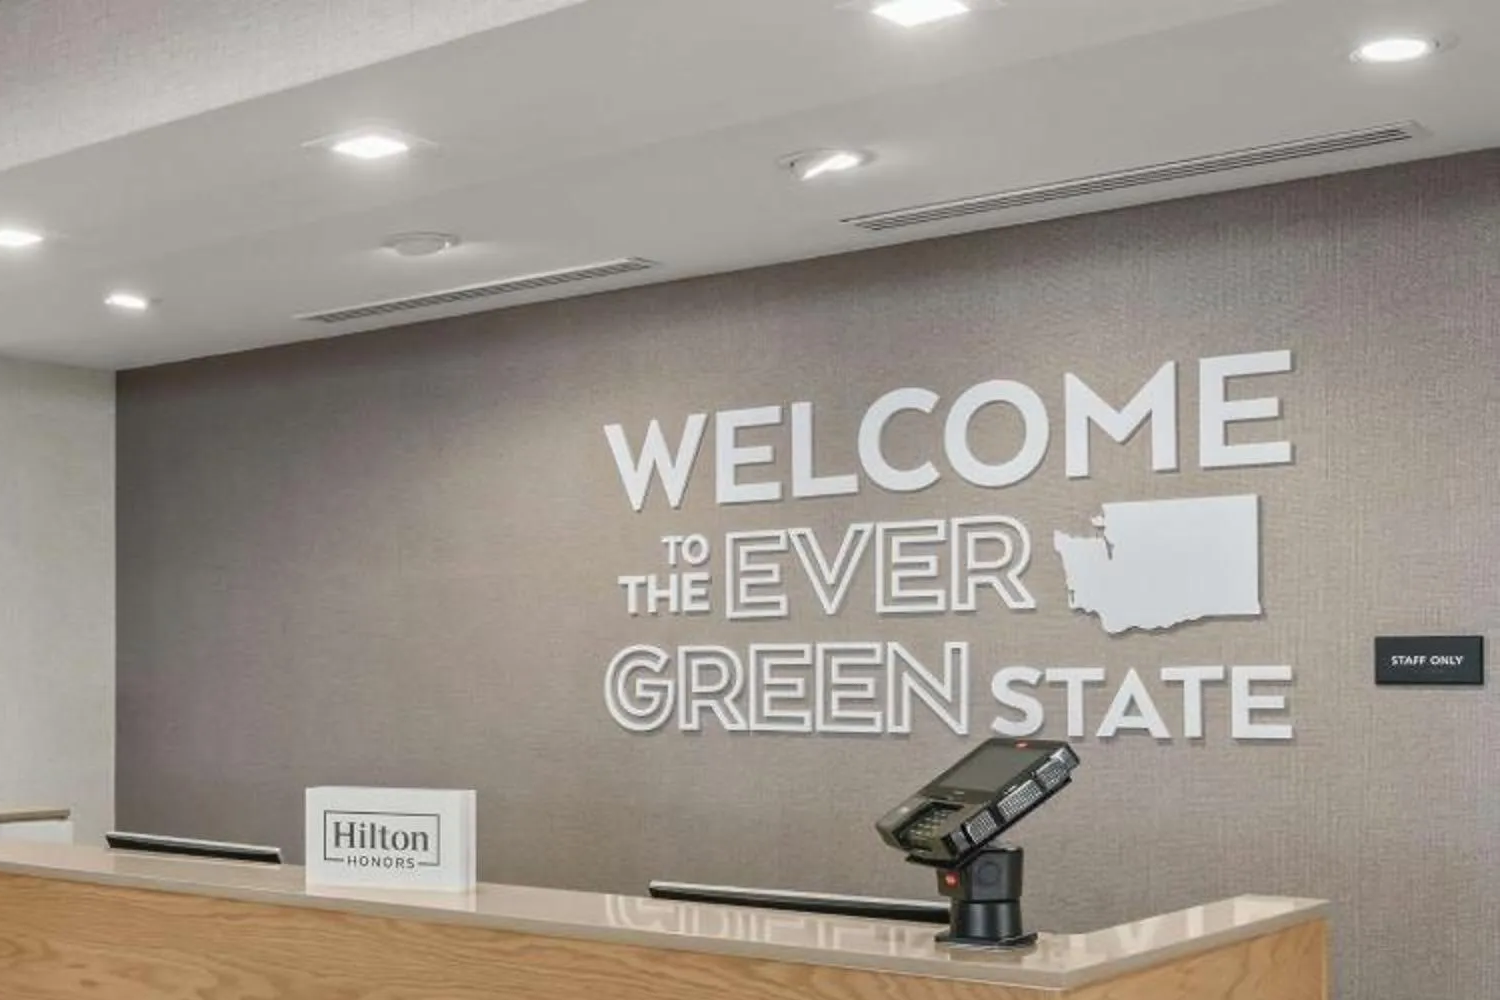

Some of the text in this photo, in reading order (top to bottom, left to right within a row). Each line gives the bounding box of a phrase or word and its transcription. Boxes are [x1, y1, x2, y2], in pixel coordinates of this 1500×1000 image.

[604, 350, 1293, 511] WELCOME
[662, 534, 709, 566] TO
[618, 516, 1036, 619] THE EVER
[1391, 655, 1464, 665] STAFF ONLY
[605, 641, 1294, 740] GREEN STATE
[333, 820, 430, 852] Hilton
[347, 855, 416, 869] HONORS
